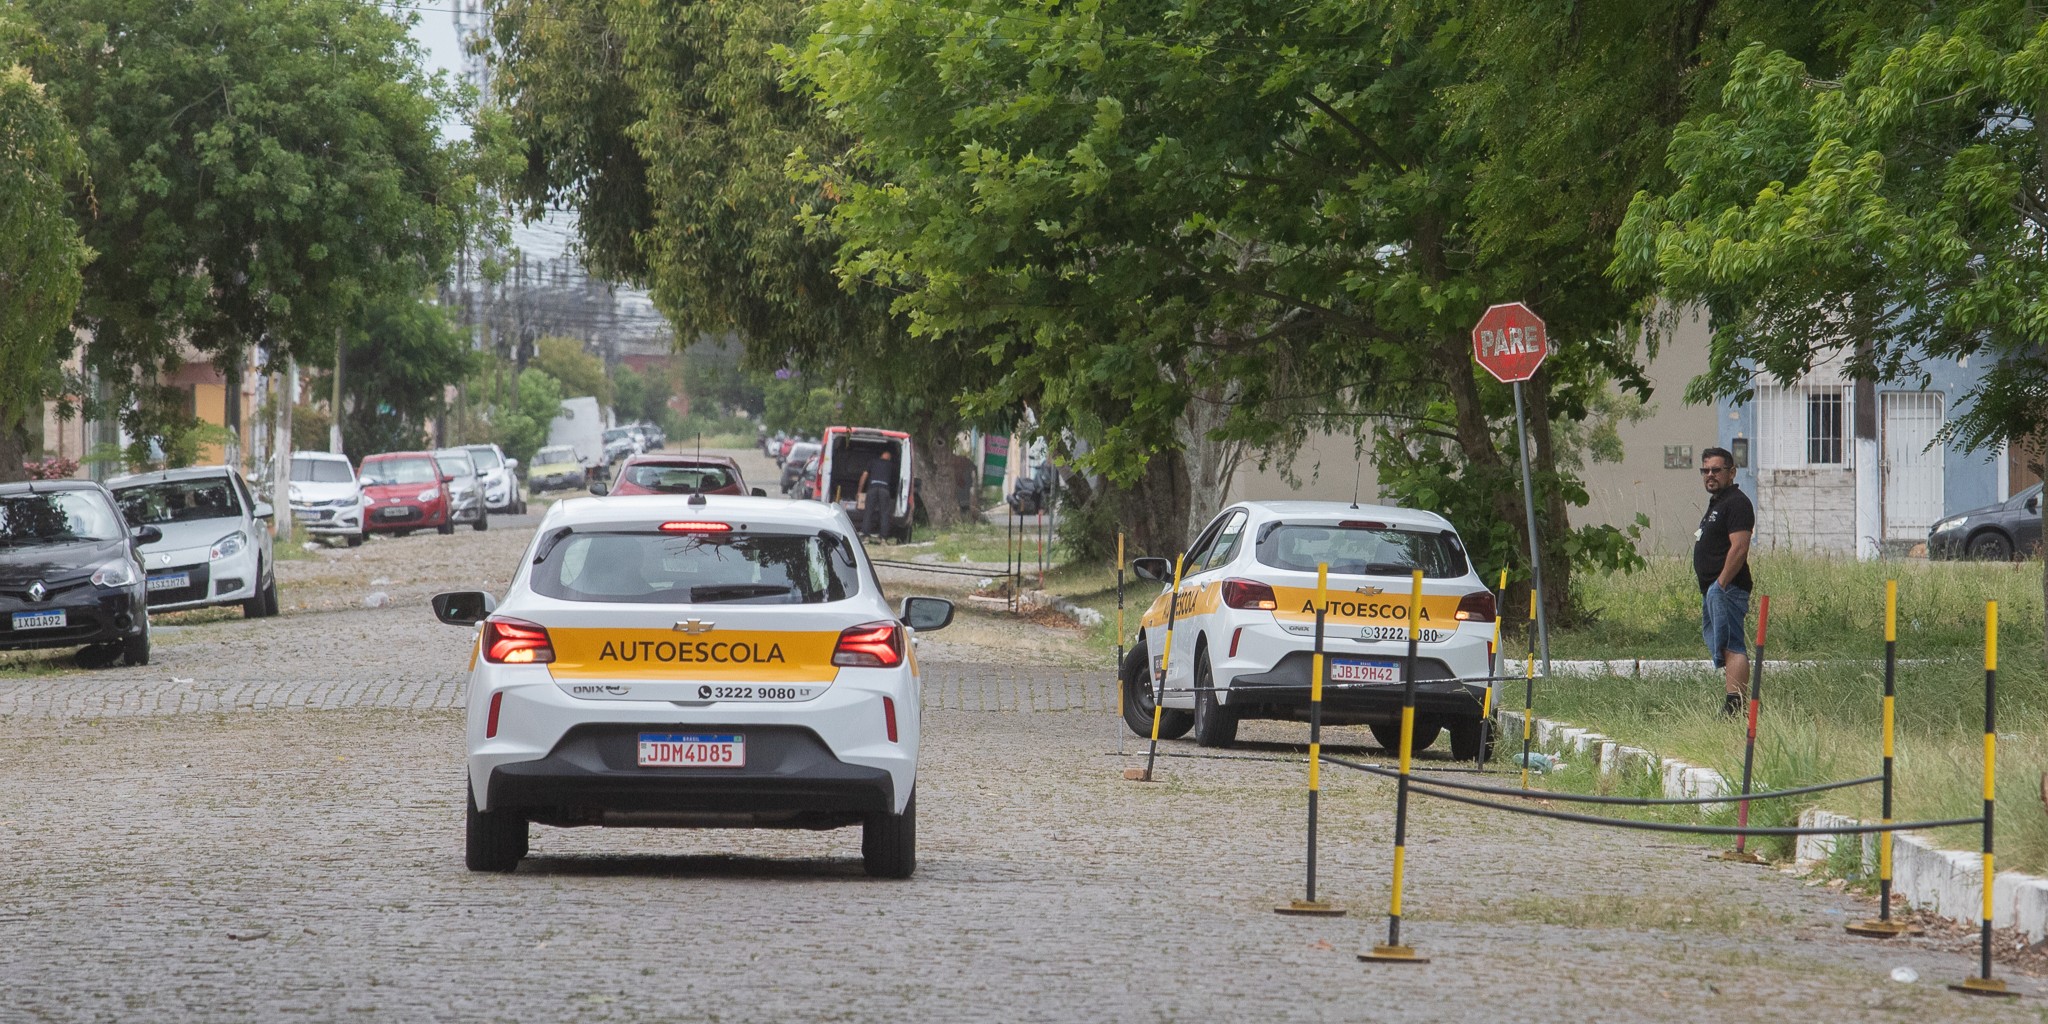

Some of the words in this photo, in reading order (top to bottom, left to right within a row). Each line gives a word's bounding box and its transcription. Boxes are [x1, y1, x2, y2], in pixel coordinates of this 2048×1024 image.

[1480, 325, 1539, 357] PARE
[1373, 626, 1438, 642] 3222.080
[599, 641, 785, 663] AUTOESCOLA
[1337, 665, 1393, 681] JBI9H42
[573, 685, 604, 693] ONIX
[715, 686, 752, 698] 3222
[758, 687, 795, 699] 9080
[800, 688, 811, 696] LT
[647, 743, 733, 763] JDM4D85
